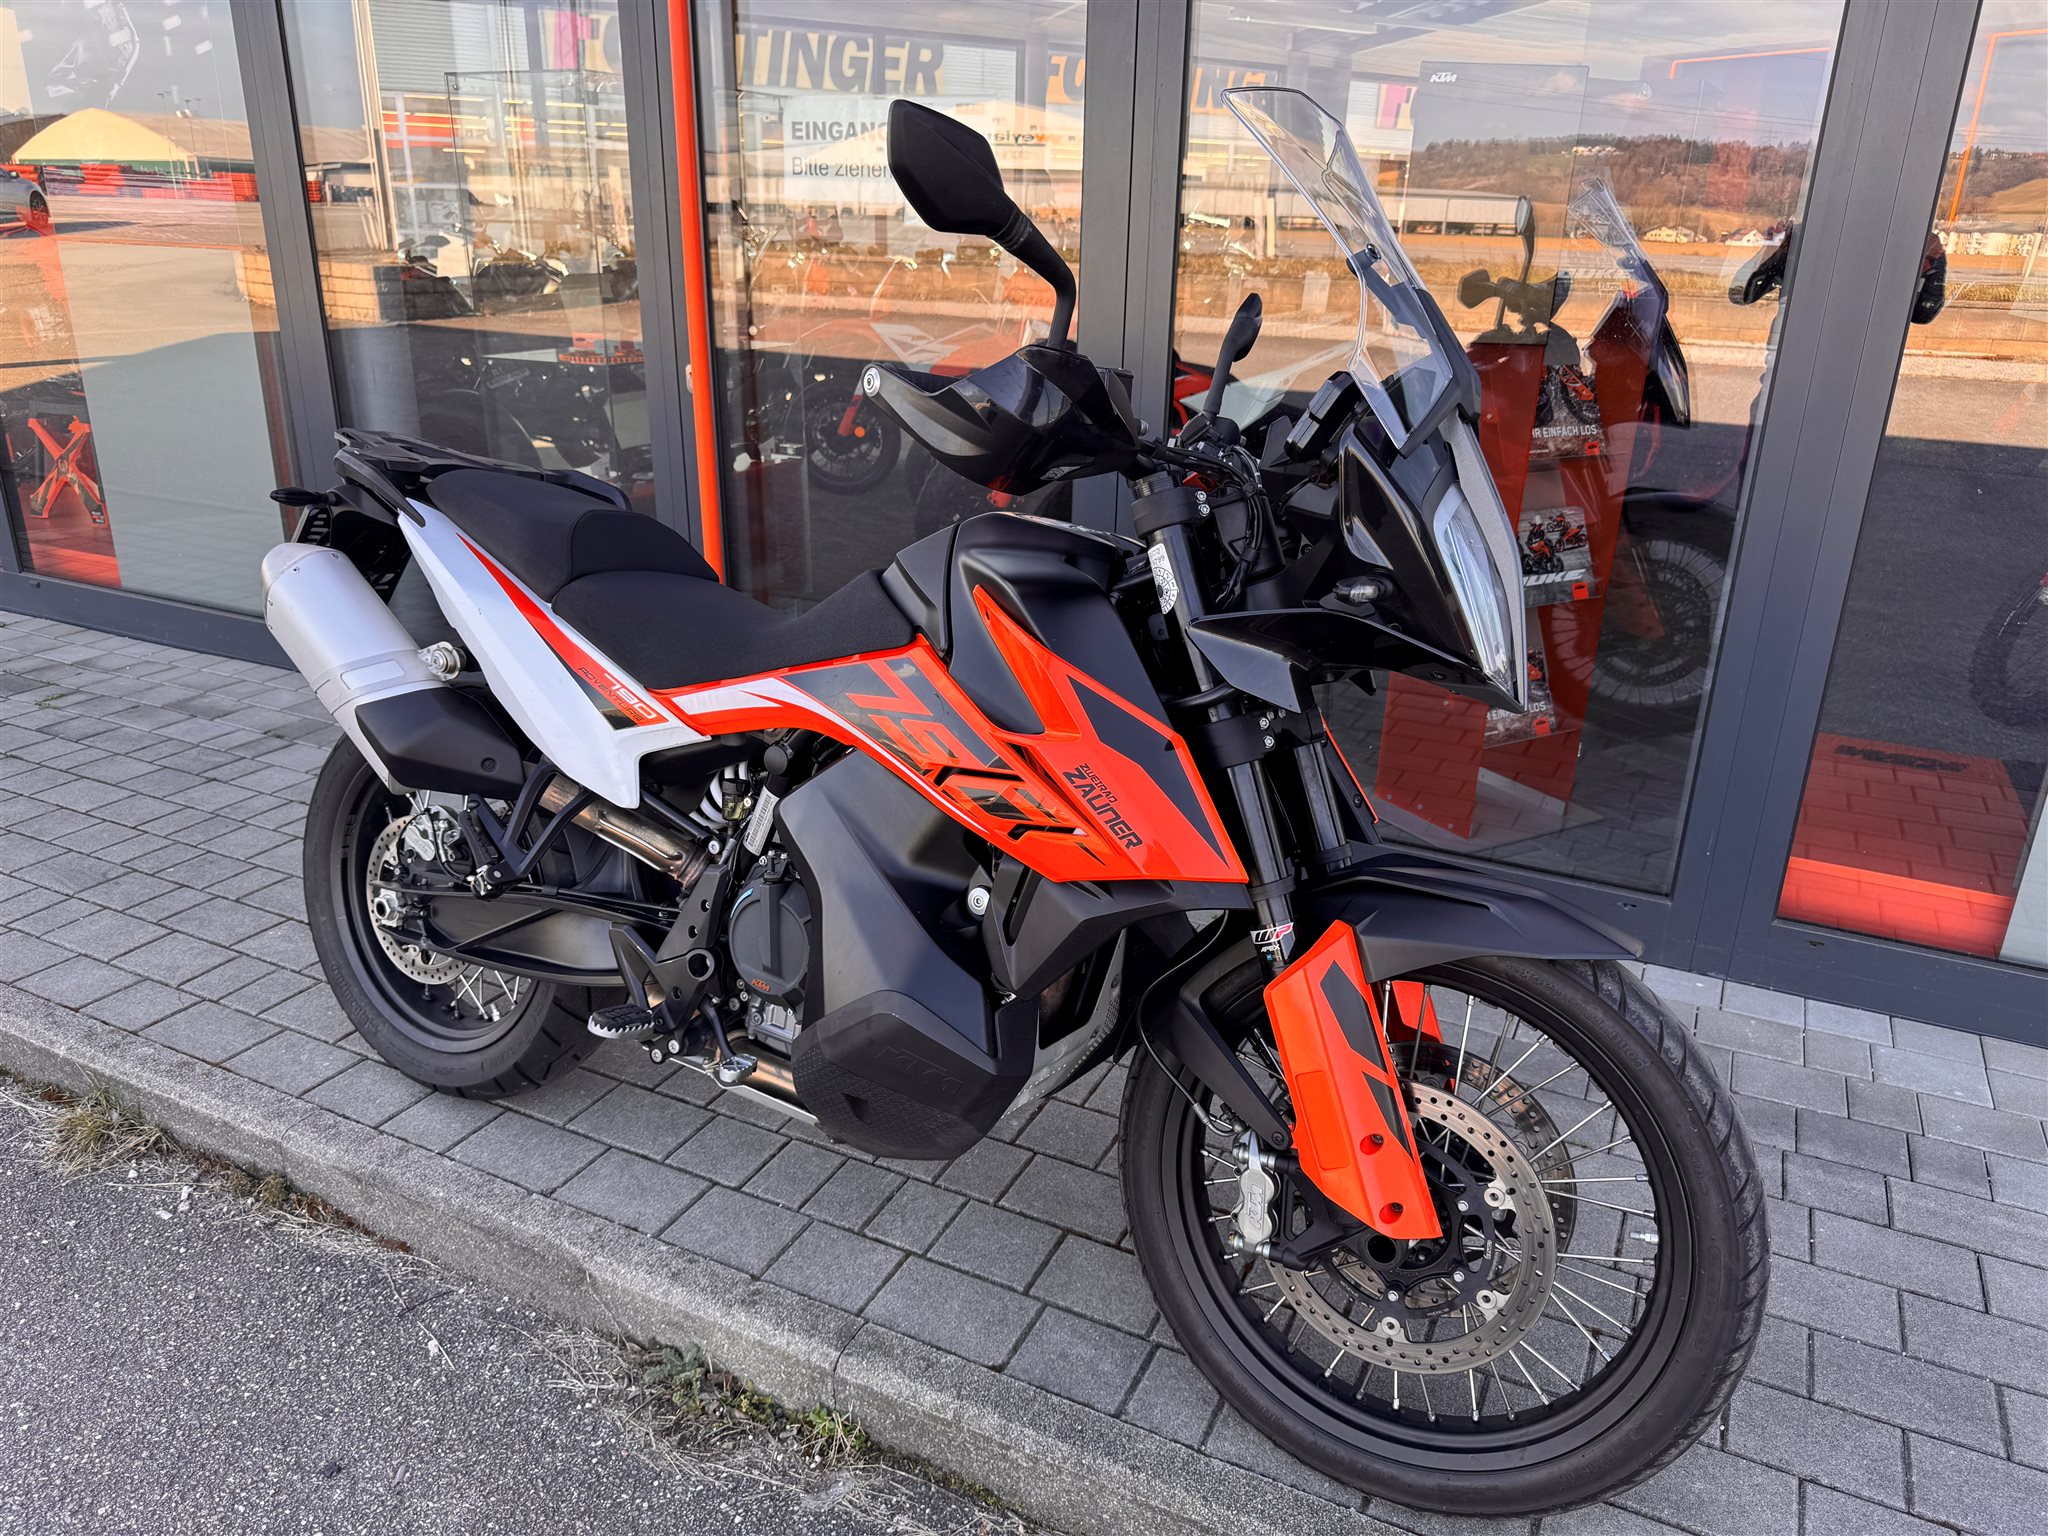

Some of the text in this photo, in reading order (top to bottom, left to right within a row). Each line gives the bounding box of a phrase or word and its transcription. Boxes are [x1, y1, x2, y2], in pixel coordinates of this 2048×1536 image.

[1430, 72, 1457, 83] KTM
[792, 156, 829, 176] Bitte
[1543, 425, 1579, 438] EINFACH
[1580, 424, 1597, 435] LOS
[577, 666, 644, 722] ADVENTURE
[604, 673, 657, 719] 790
[1528, 701, 1546, 713] LOS
[1080, 762, 1118, 804] ZWEIRAD
[1062, 767, 1143, 849] ZAUNER
